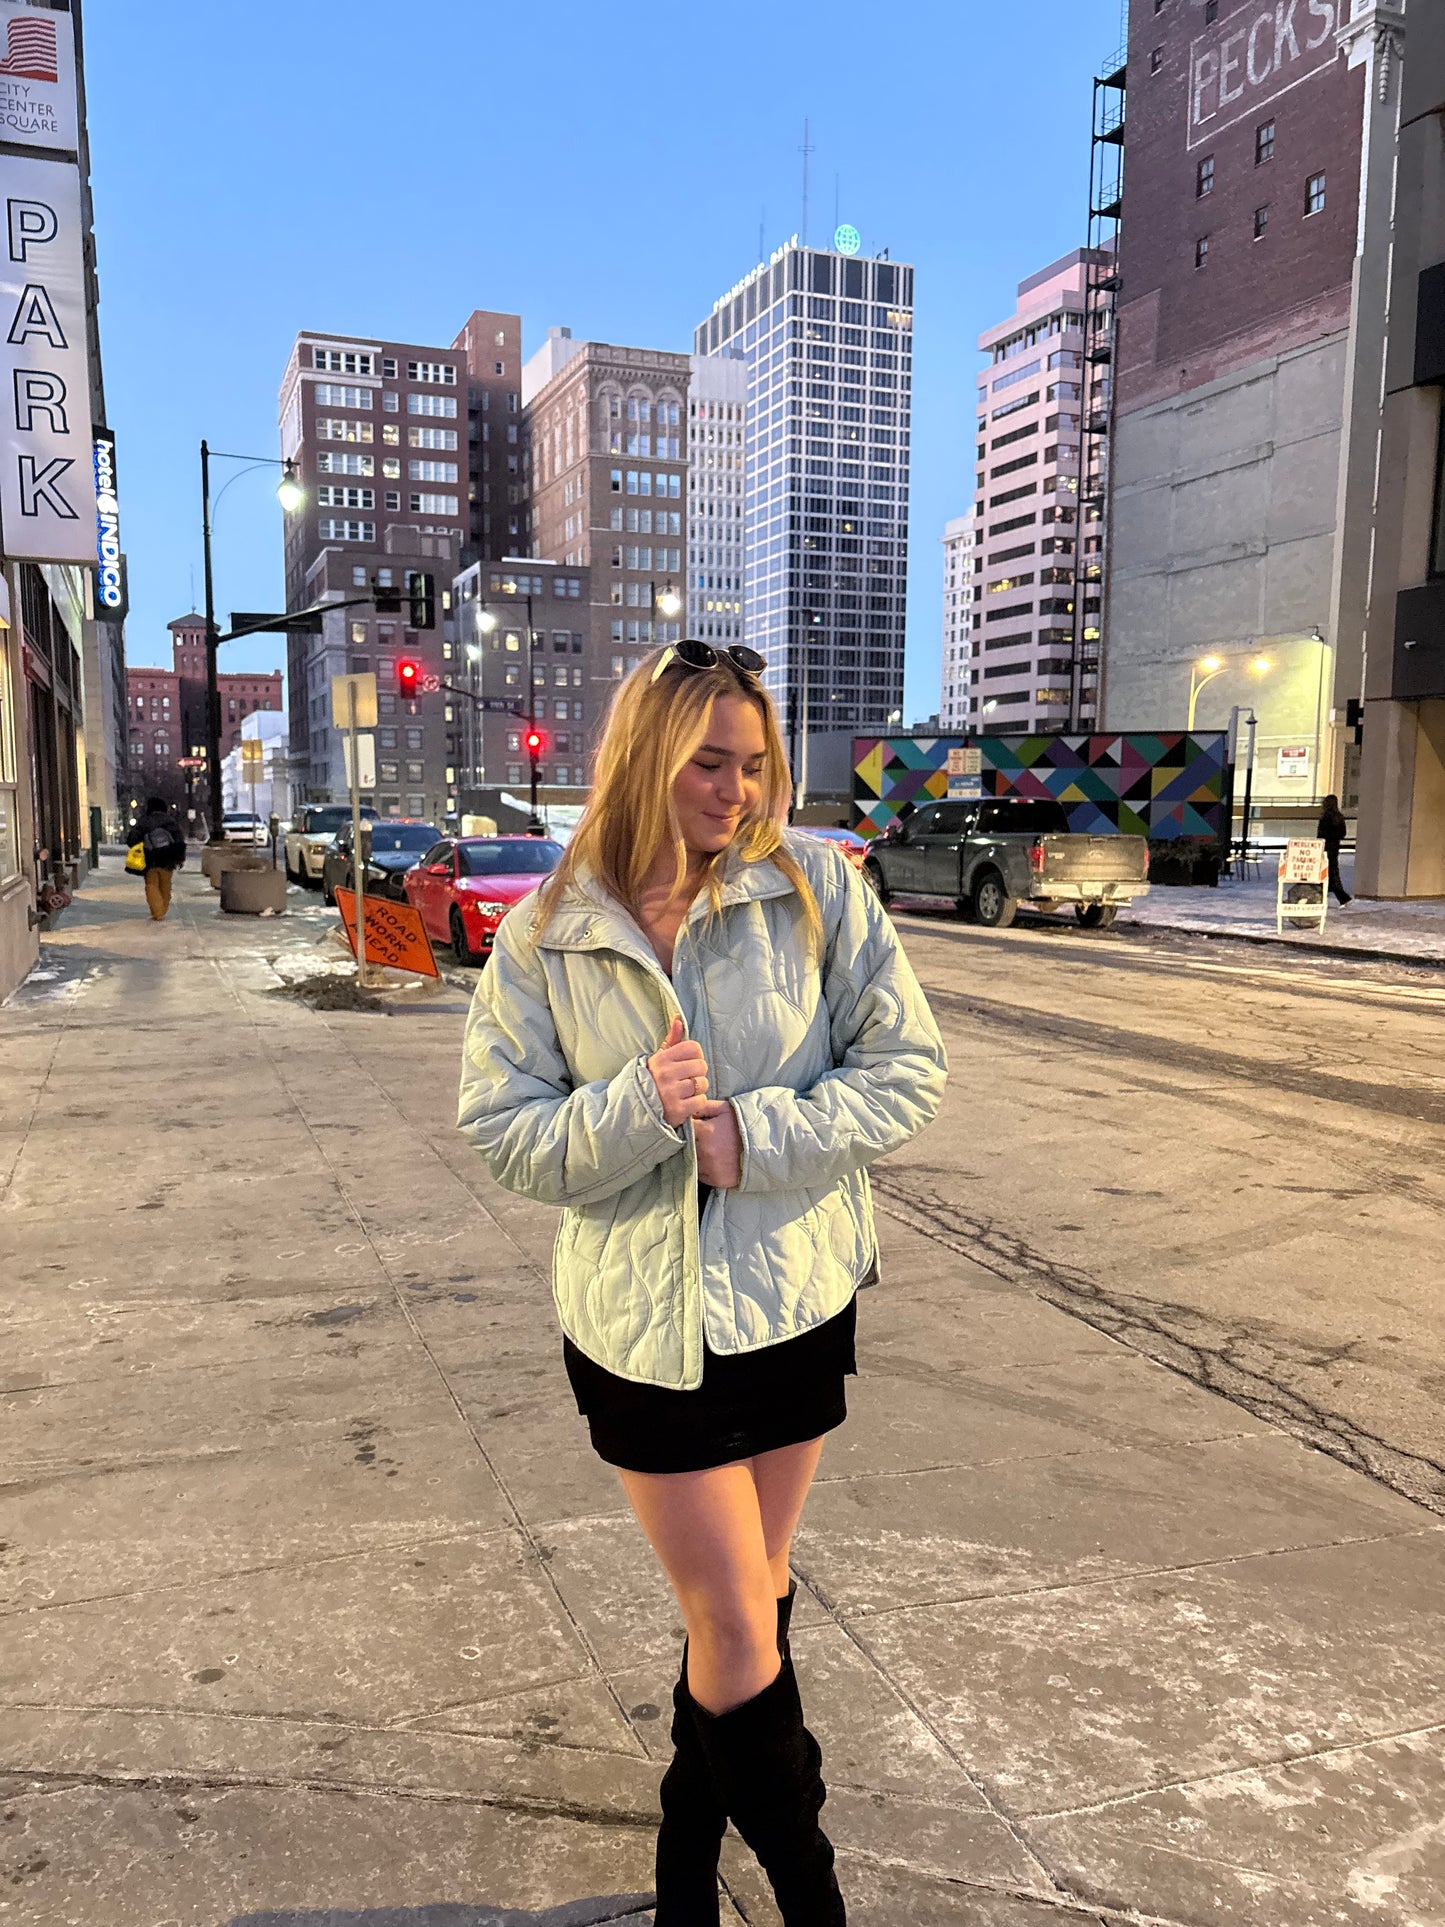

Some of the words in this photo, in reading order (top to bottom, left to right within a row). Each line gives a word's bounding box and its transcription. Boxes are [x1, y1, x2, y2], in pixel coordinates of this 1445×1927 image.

[0, 82, 31, 98] CITY
[0, 97, 54, 117] CENTER
[0, 112, 58, 133] SQUARE
[7, 198, 79, 519] PARK
[96, 439, 116, 496] hotel
[101, 513, 121, 608] INDIGO
[1299, 849, 1311, 857] NO
[365, 914, 408, 952] WORK
[376, 906, 417, 943] ROAD
